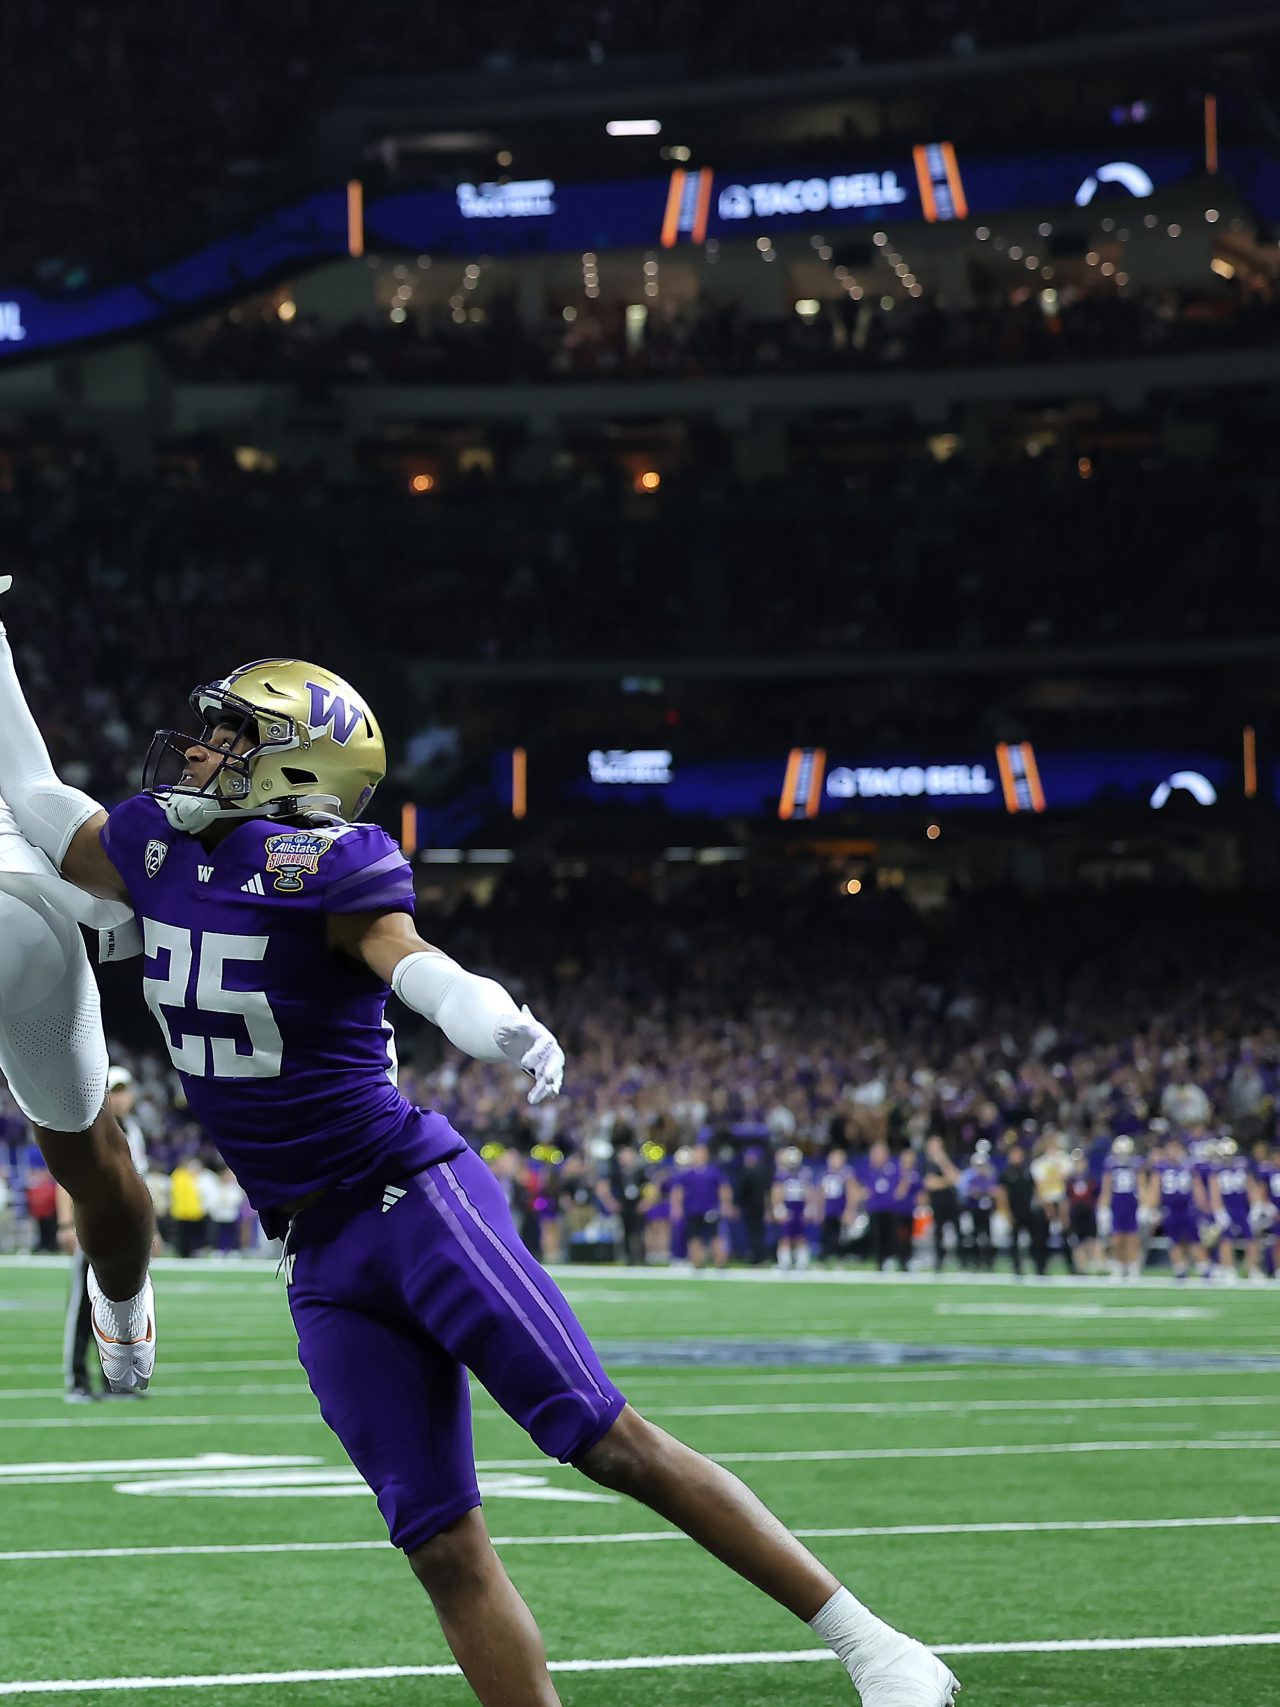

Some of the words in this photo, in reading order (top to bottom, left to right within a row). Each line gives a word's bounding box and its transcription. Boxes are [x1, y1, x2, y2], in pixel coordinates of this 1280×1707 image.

[747, 177, 829, 217] TACO
[829, 170, 906, 209] BELL
[304, 680, 363, 748] W
[146, 841, 167, 865] PAC
[273, 842, 318, 854] Allstate
[147, 856, 159, 871] 12
[197, 864, 215, 883] W
[143, 917, 283, 1078] 25
